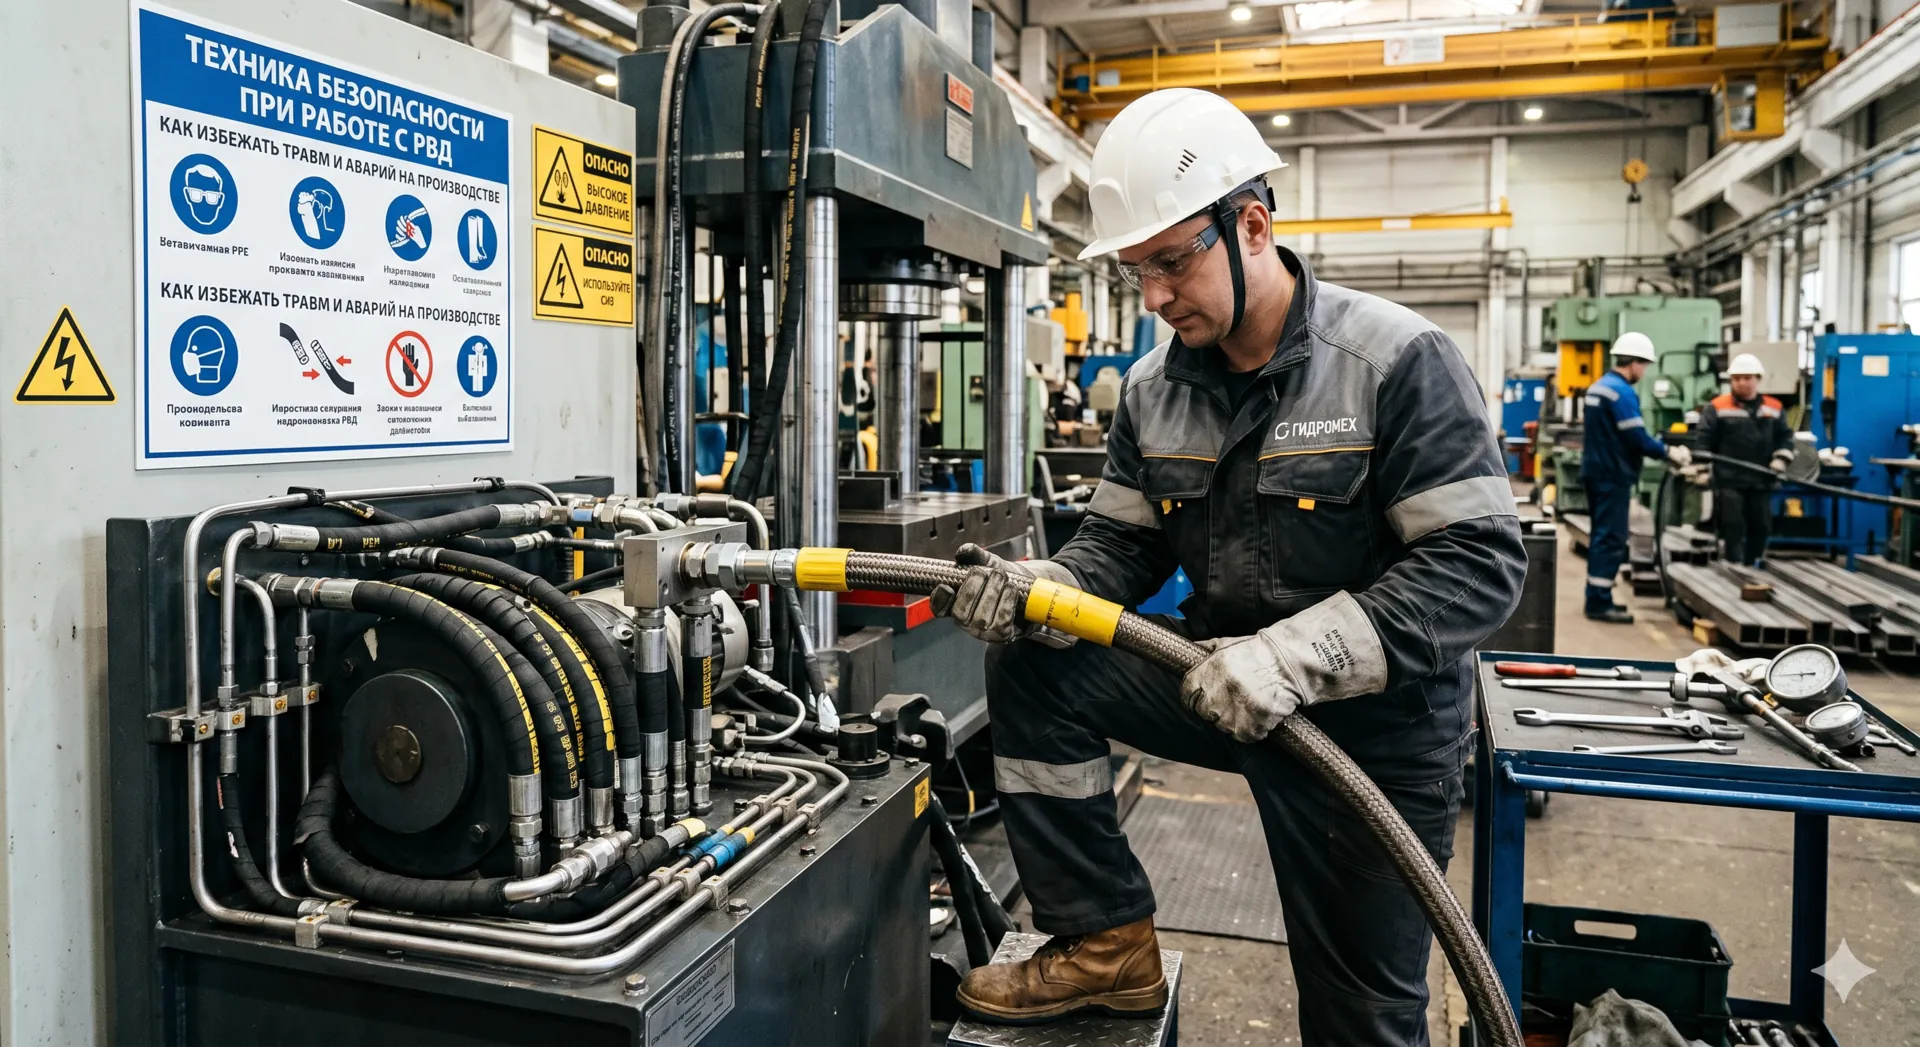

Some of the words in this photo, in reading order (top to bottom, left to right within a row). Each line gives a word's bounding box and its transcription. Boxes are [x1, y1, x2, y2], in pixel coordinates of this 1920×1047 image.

[185, 33, 313, 94] ТЕХНИКА
[318, 72, 484, 142] БЕЗОПАСНОСТИ
[240, 86, 294, 125] ПРИ
[301, 102, 390, 147] РАБОТЕ
[395, 128, 408, 152] С
[414, 136, 453, 168] РВД
[160, 115, 193, 138] КАК
[197, 123, 280, 156] ИЗБЕЖАТЬ
[282, 143, 330, 168] ТРАВМ
[333, 154, 342, 169] И
[345, 157, 396, 182] АВАРИЙ
[399, 170, 415, 186] НА
[417, 174, 500, 204] ПРОИЗВОДСТВЕ
[584, 152, 629, 178] ОПАСНО
[587, 183, 627, 204] ВЫСОКОЕ
[585, 200, 630, 222] ДАВЛЕНИЕ
[584, 246, 629, 267] ОПАСНО
[583, 277, 630, 294] ИСПОЛЬЗУЙТЕ
[161, 282, 194, 300] КАК
[199, 285, 280, 307] ИЗБЕЖАТЬ
[283, 293, 330, 312] ТРАВМ
[333, 299, 342, 312] И
[345, 300, 396, 317] АВАРИЙ
[399, 304, 415, 319] НА
[418, 306, 500, 326] ПРОИЗВОДСТВЕ
[600, 295, 614, 307] СИЗ
[342, 416, 357, 425] РВД
[1292, 418, 1357, 438] ГИДРОМЕХ
